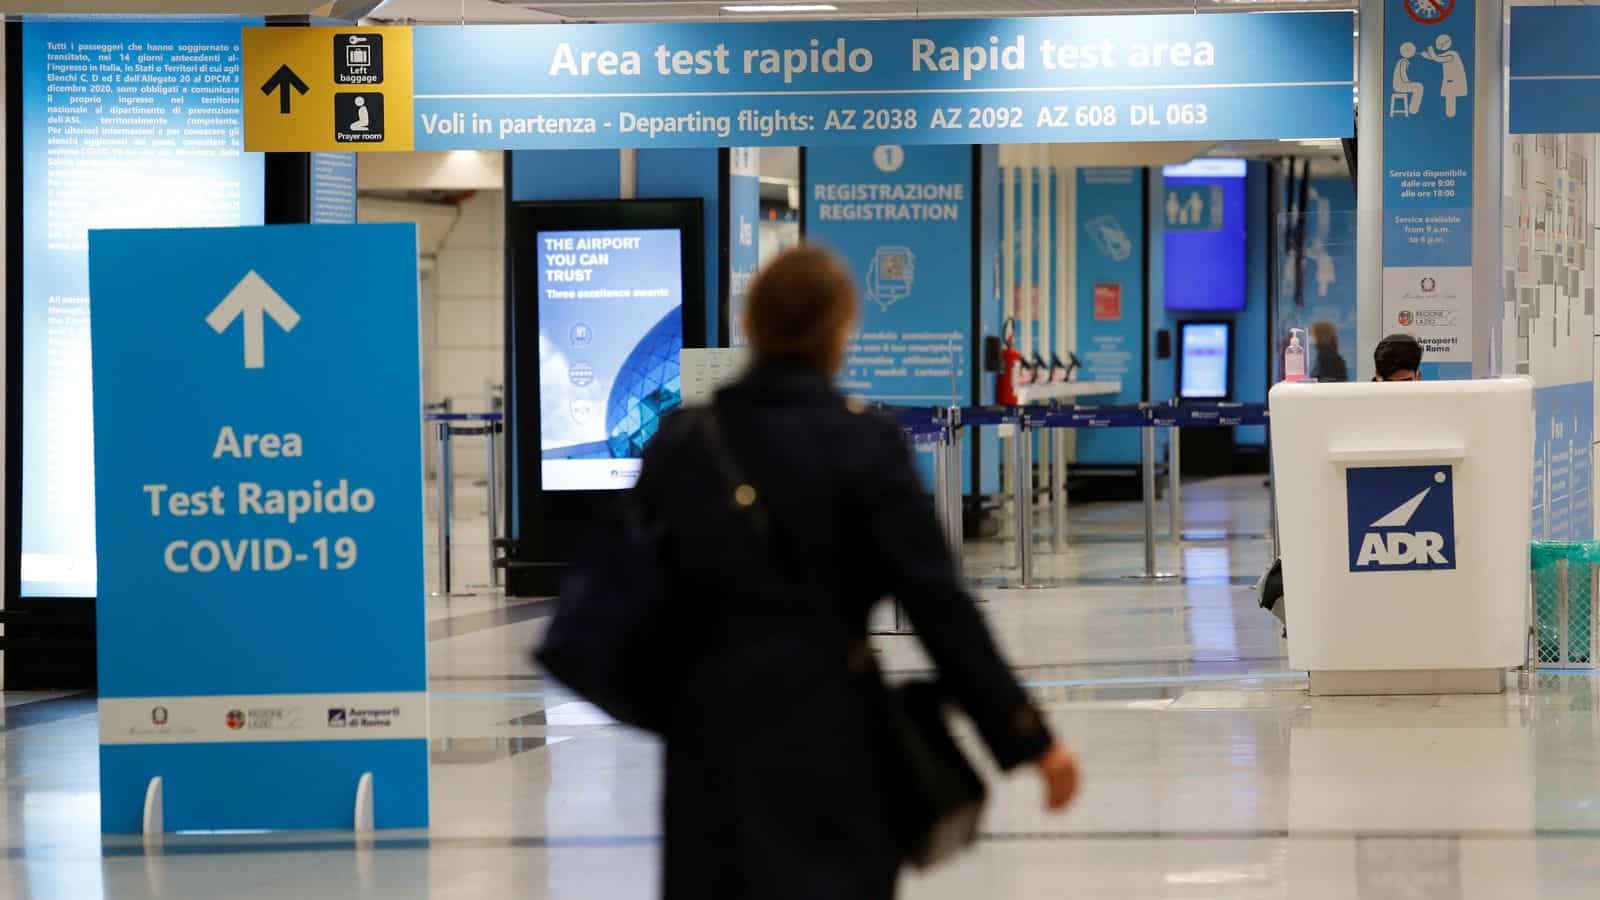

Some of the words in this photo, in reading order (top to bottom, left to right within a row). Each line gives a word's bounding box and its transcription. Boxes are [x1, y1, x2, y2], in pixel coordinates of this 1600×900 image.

[47, 42, 66, 50] Tutti
[78, 43, 123, 53] passeggeri
[128, 43, 143, 51] che
[178, 43, 229, 53] soggiornato
[138, 54, 163, 63] giorni
[171, 54, 220, 62] antecedenti
[549, 42, 641, 76] Area
[655, 42, 730, 75] test
[743, 38, 874, 83] rapido
[912, 36, 1025, 80] Rapid
[1040, 38, 1115, 67] test
[1128, 40, 1215, 66] area
[135, 64, 154, 72] Stati
[47, 74, 77, 82] Elenchi
[102, 74, 112, 82] ed
[205, 75, 231, 83] DPCM
[340, 74, 377, 83] baggage
[47, 84, 87, 92] dicembre
[70, 96, 102, 104] proprio
[421, 111, 465, 134] Voli
[472, 110, 493, 133] in
[500, 114, 596, 139] partenza
[619, 110, 731, 138] Departing
[738, 108, 815, 136] flights:
[824, 109, 856, 130] AZ
[863, 109, 917, 130] 2038
[930, 108, 962, 129] AZ
[968, 107, 1023, 128] 2092
[1036, 107, 1069, 127] AZ
[1075, 105, 1116, 126] 608
[1130, 105, 1160, 125] DL
[1166, 104, 1208, 125] 063
[337, 133, 361, 141] Prayer
[1389, 169, 1421, 178] Servizio
[1422, 168, 1467, 179] disponibile
[1401, 179, 1420, 188] dalle
[814, 184, 965, 201] REGISTRAZIONE
[819, 204, 959, 221] REGISTRATION
[1404, 225, 1424, 233] from
[545, 238, 573, 251] THE
[576, 236, 641, 250] AIRPORT
[545, 253, 576, 266] YOU
[579, 252, 609, 266] CAN
[545, 269, 593, 282] TRUST
[546, 289, 575, 299] Three
[577, 287, 631, 298] excellence
[633, 287, 670, 298] awards
[212, 426, 303, 458] Area
[143, 484, 225, 516] Test
[238, 478, 375, 524] Rapido
[1356, 530, 1449, 566] ADR
[164, 536, 358, 573] COVID-19
[350, 706, 400, 718] Aeroporti
[350, 719, 359, 728] di
[361, 718, 391, 728] Roma
